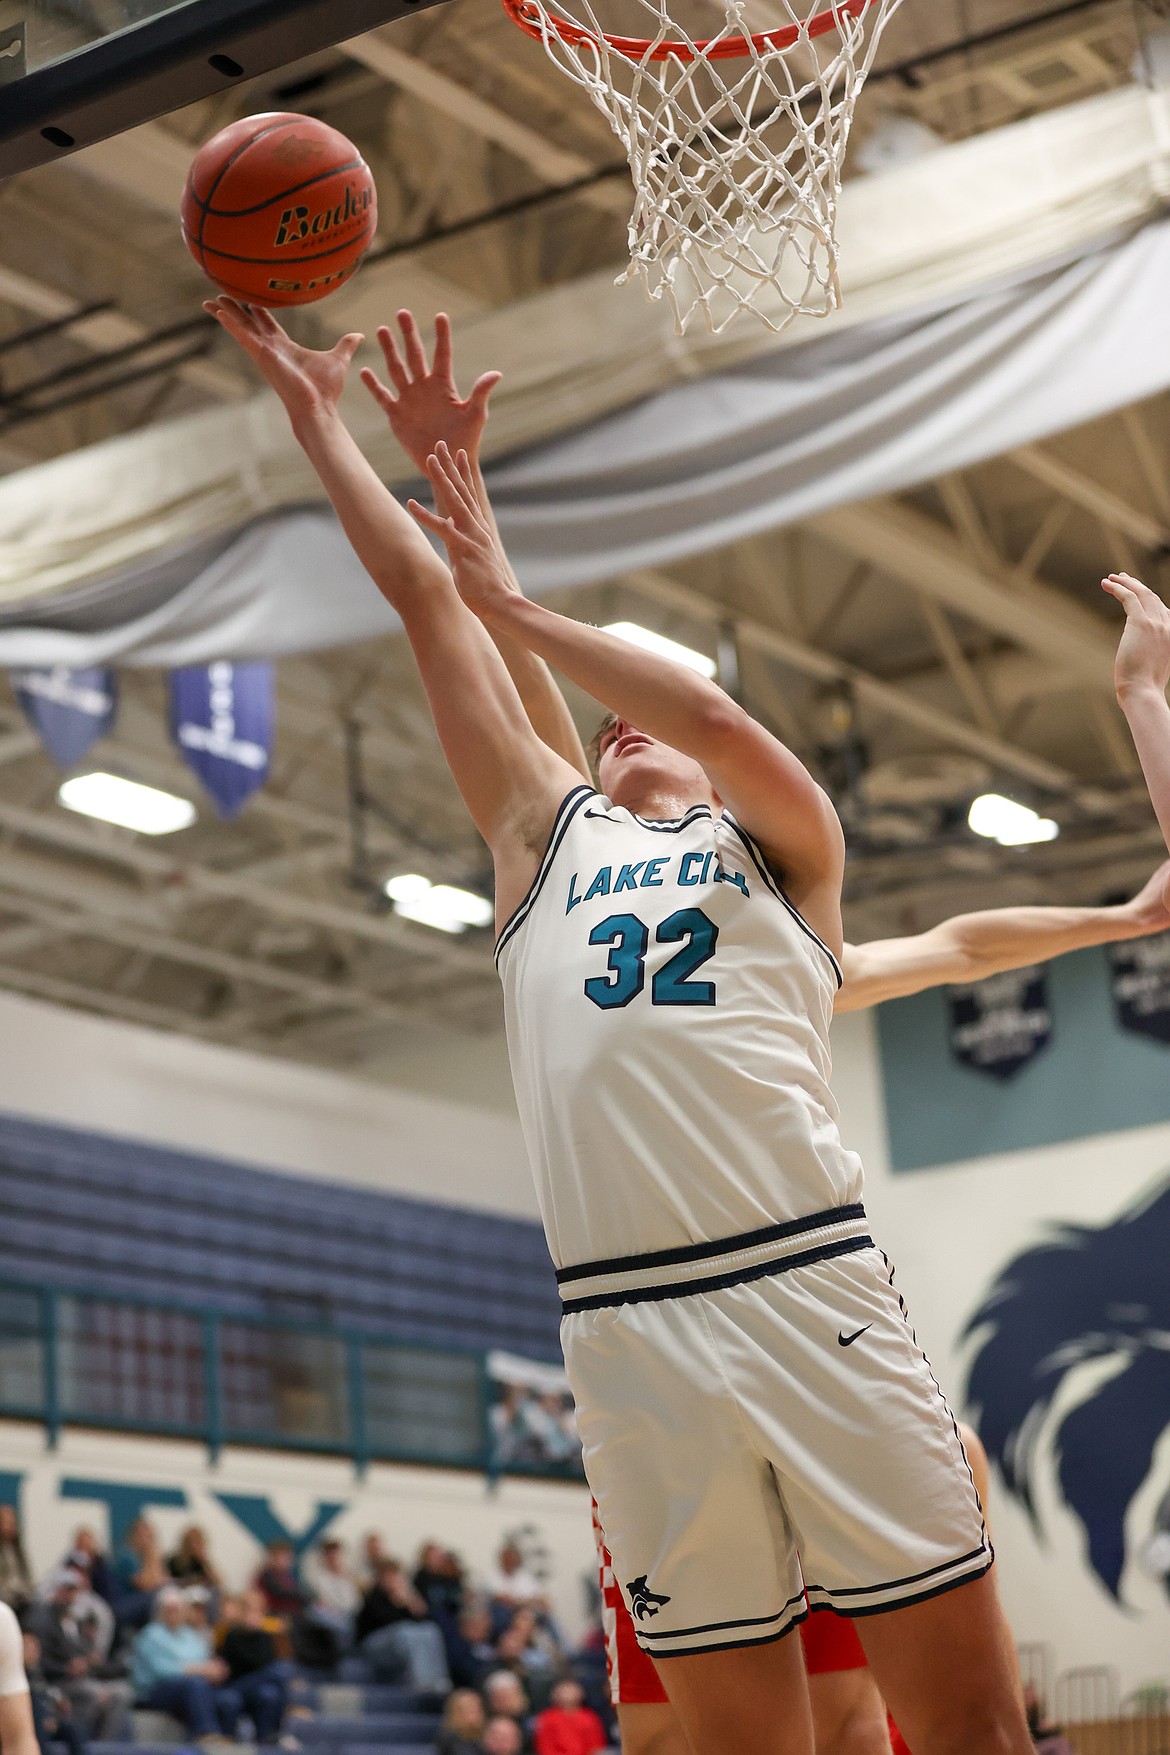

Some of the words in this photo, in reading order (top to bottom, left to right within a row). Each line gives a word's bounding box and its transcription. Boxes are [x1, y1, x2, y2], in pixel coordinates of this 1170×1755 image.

[274, 185, 372, 247] Baden
[565, 856, 671, 916] LAKE
[584, 907, 719, 1010] 32
